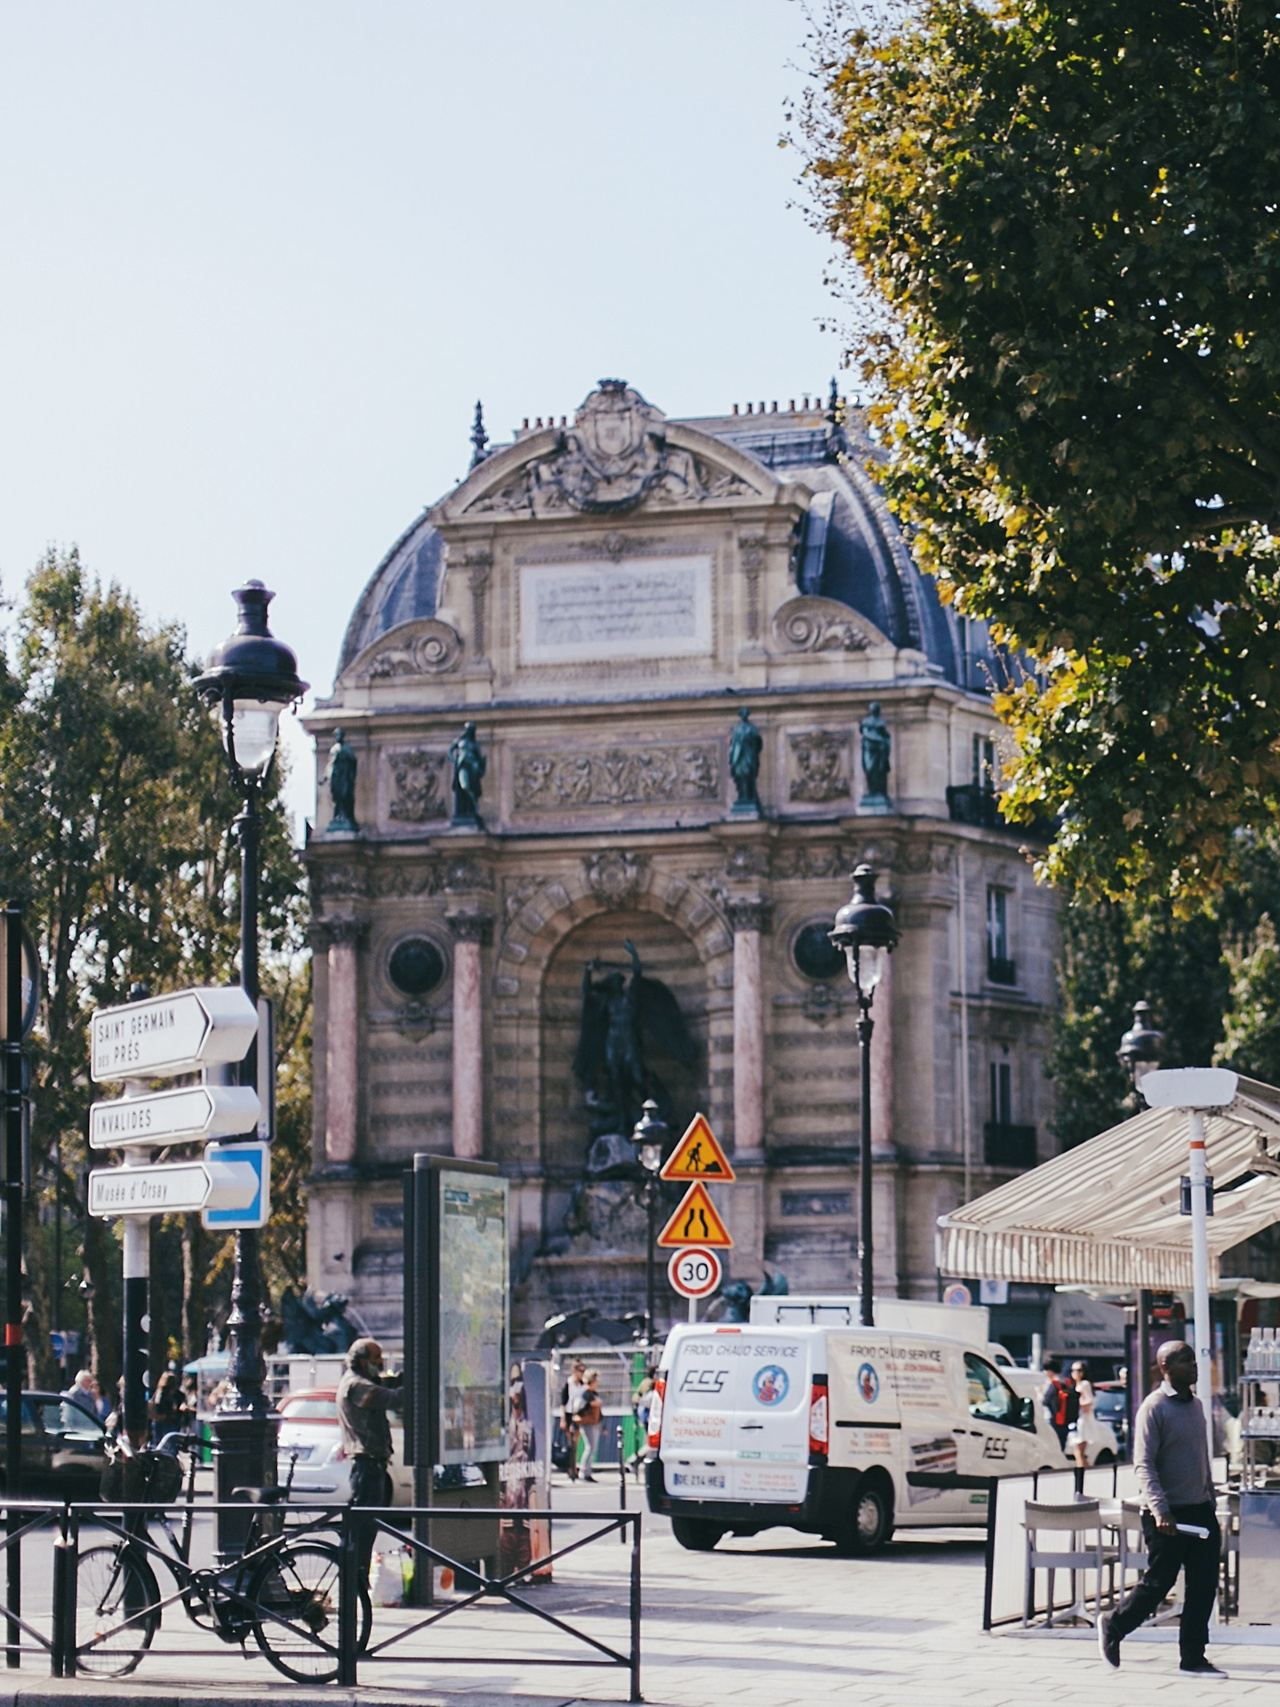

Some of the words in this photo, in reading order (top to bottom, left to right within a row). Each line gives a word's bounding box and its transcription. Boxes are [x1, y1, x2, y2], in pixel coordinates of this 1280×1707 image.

[98, 1020, 125, 1042] SAINT
[131, 1008, 175, 1035] GERMAIN
[113, 1038, 140, 1064] PRÉS
[96, 1108, 152, 1135] INVALIDES
[96, 1183, 126, 1203] Musée
[683, 1262, 709, 1281] 30
[683, 1343, 713, 1356] FROID
[716, 1344, 751, 1357] CHAUD
[753, 1345, 798, 1358] SERVICE
[850, 1345, 876, 1358] FROID
[878, 1346, 906, 1360] CHAUD
[908, 1348, 941, 1362] SERVICE
[671, 1415, 726, 1426] INSTALLATION
